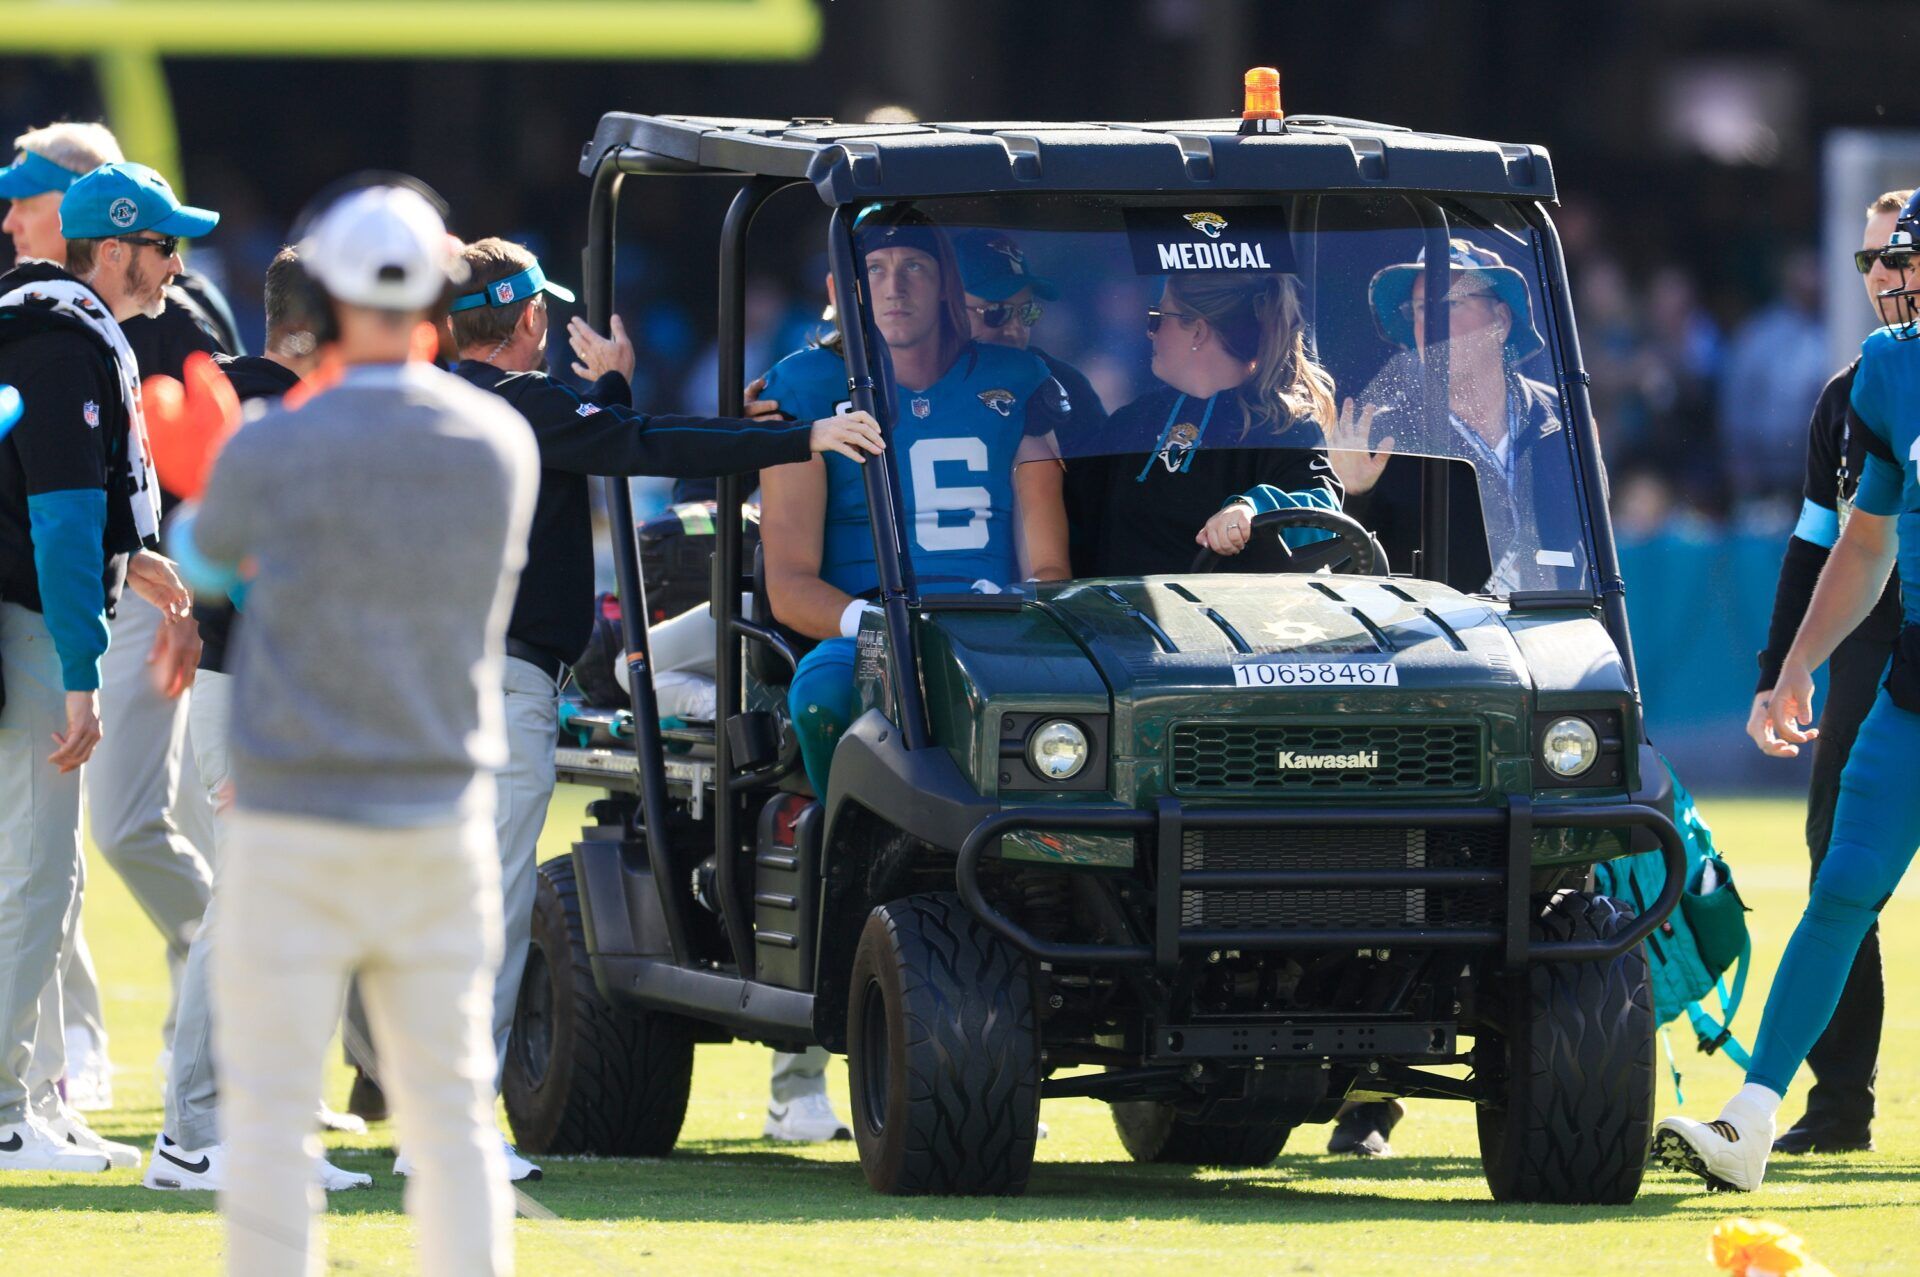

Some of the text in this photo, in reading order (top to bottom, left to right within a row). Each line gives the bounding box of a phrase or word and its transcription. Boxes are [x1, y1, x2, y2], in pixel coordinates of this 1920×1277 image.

[1157, 242, 1271, 269] MEDICAL
[909, 437, 992, 551] 6
[1238, 664, 1393, 685] 10658467
[1278, 751, 1379, 769] Kawasaki
